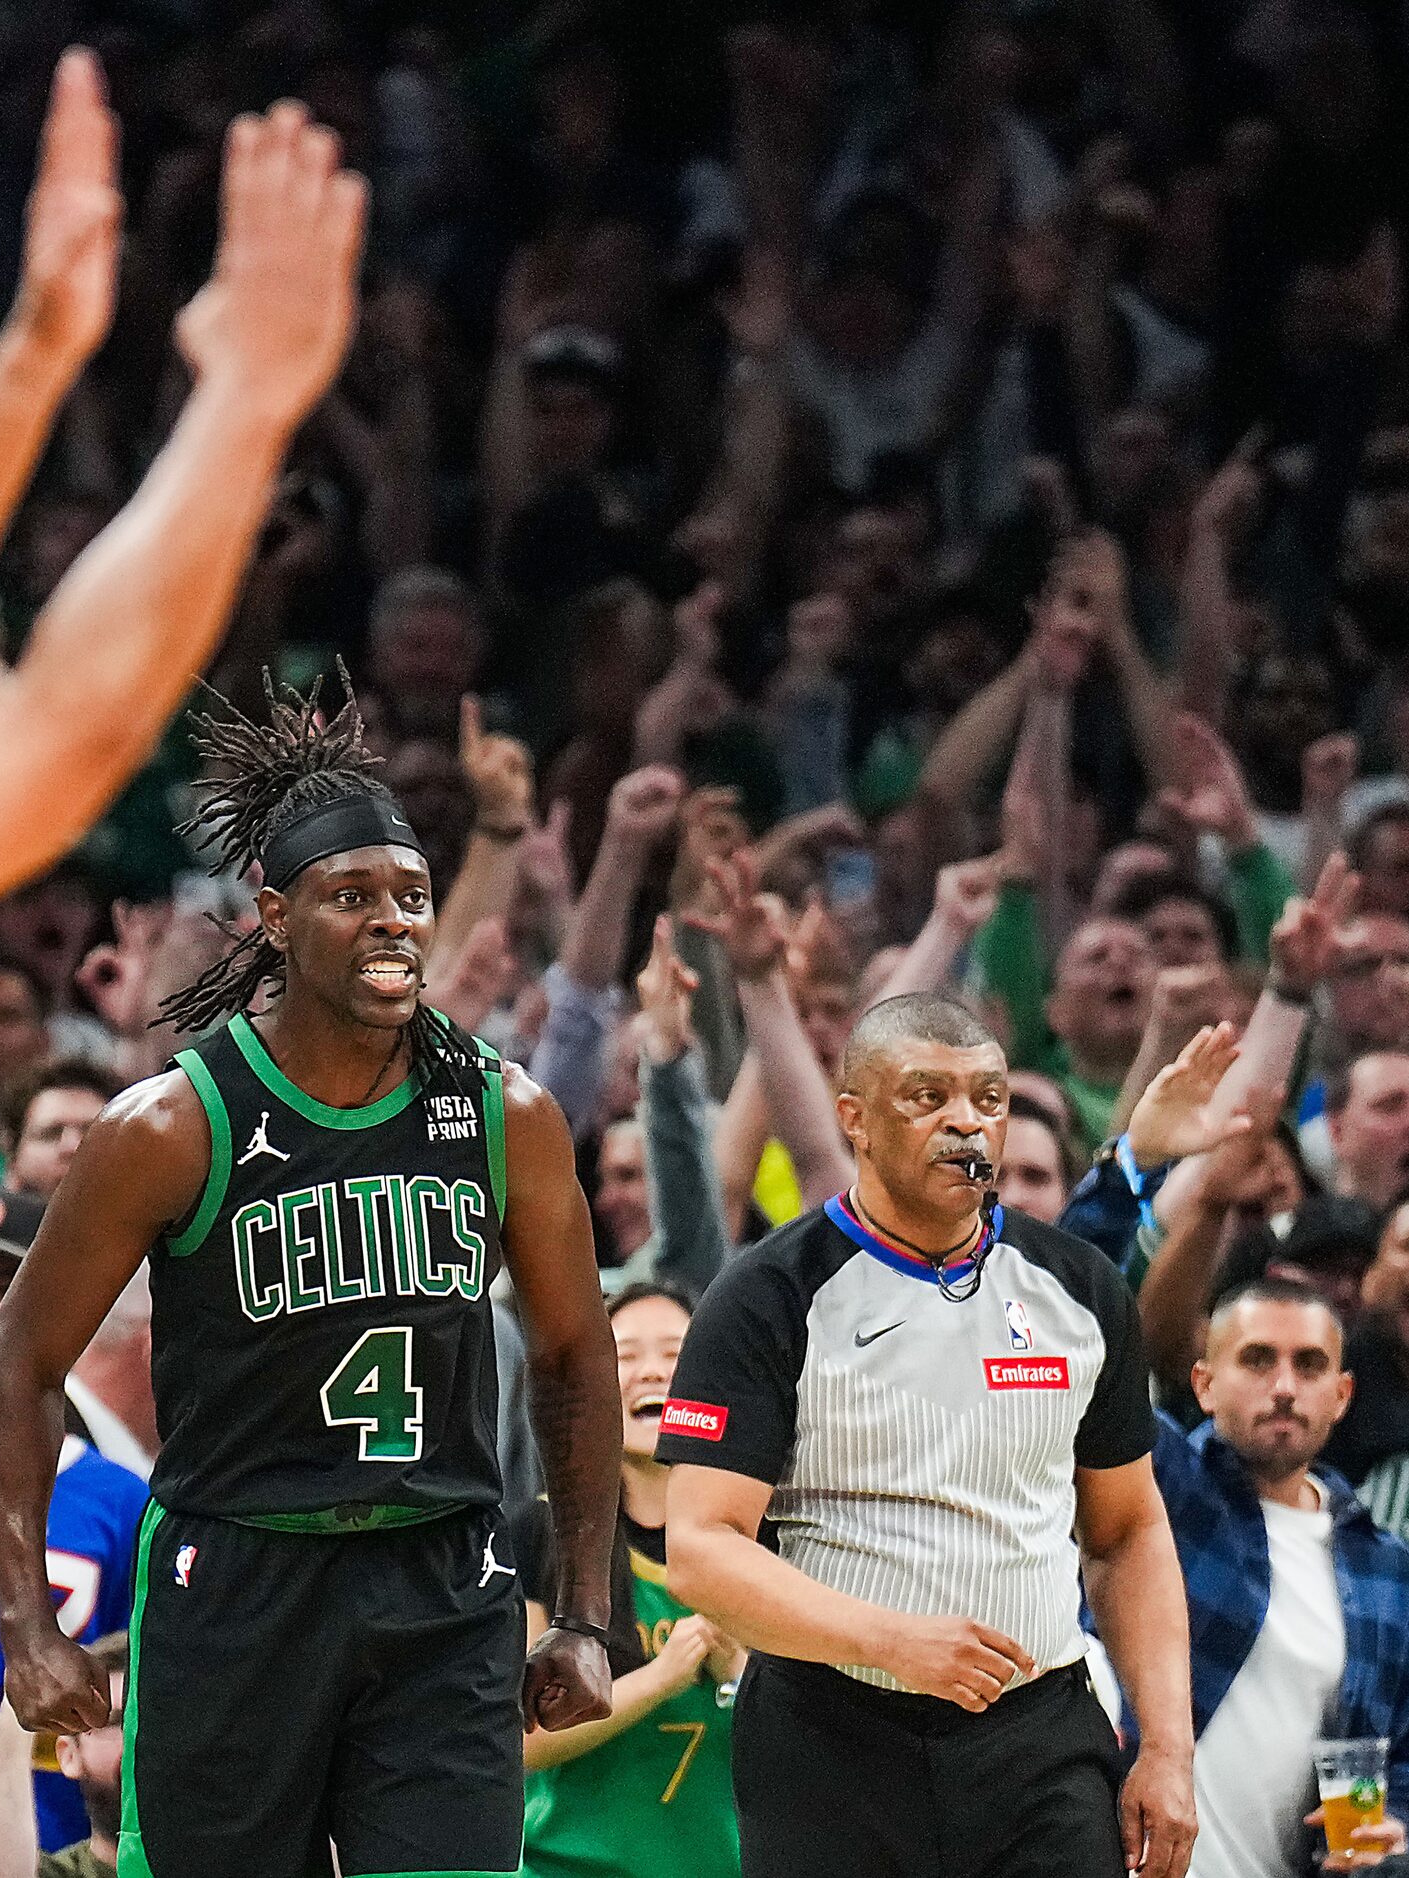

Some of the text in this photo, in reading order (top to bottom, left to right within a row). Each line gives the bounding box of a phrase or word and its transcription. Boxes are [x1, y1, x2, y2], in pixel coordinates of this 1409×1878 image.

[428, 1120, 478, 1141] PRINT
[232, 1175, 485, 1322] CELTICS
[320, 1326, 423, 1462] 4
[990, 1364, 1063, 1382] Emirates
[664, 1405, 718, 1430] Emirates
[658, 1721, 705, 1803] 7
